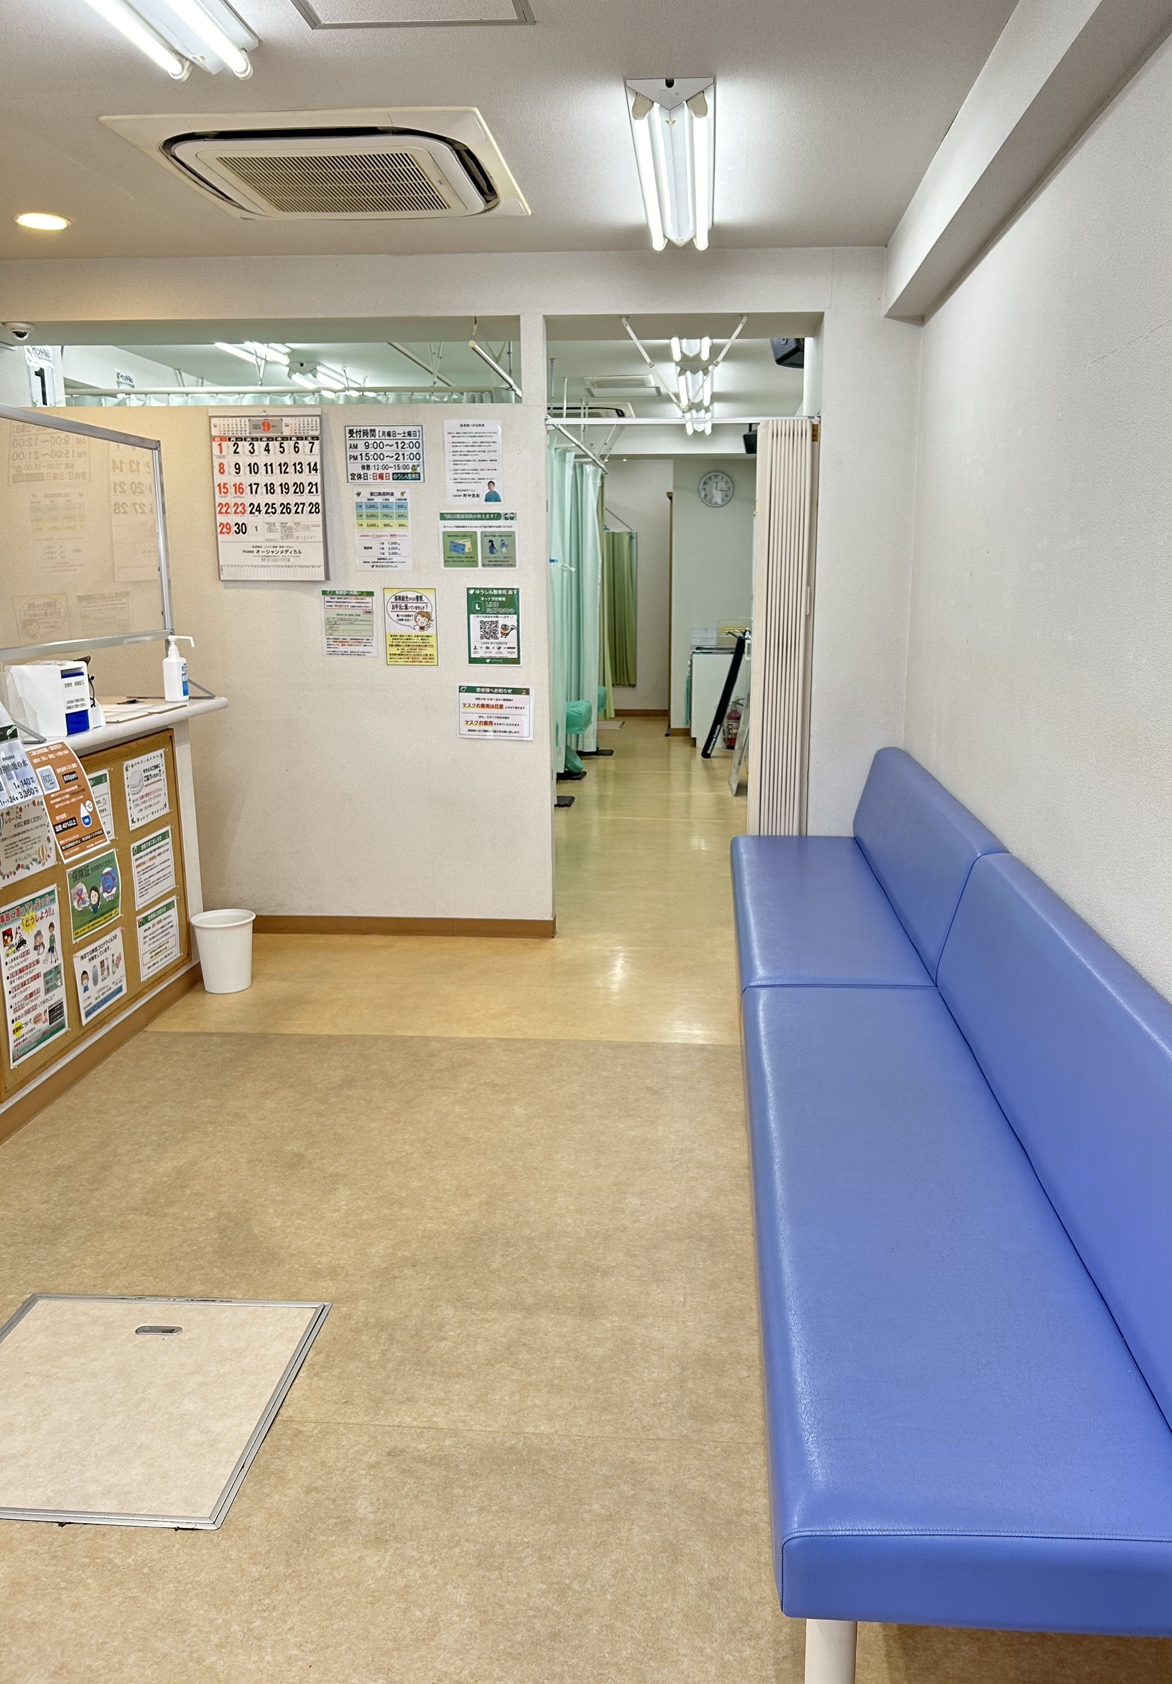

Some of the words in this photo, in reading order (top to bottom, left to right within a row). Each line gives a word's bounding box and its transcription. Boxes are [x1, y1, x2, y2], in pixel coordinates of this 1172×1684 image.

[34, 367, 48, 406] 1
[262, 421, 270, 432] 9
[348, 429, 376, 438] 受付時間
[218, 442, 223, 454] 1
[233, 442, 239, 454] 2
[249, 442, 255, 454] 3
[264, 442, 270, 454] 4
[280, 442, 285, 454] 5
[294, 442, 300, 454] 6
[309, 442, 315, 453] 7
[219, 463, 225, 474] 8
[234, 462, 240, 474] 9
[248, 462, 259, 474] 10
[264, 462, 274, 474] 11
[278, 462, 289, 474] 12
[293, 462, 303, 474] 13
[307, 462, 318, 474] 14
[217, 483, 229, 494] 15
[233, 483, 244, 494] 16
[248, 483, 259, 494] 17
[264, 483, 275, 494] 18
[279, 482, 289, 494] 19
[293, 482, 304, 494] 20
[308, 482, 318, 494] 21
[218, 503, 230, 514] 22
[233, 503, 246, 514] 23
[249, 503, 262, 514] 24
[264, 503, 276, 514] 25
[280, 503, 291, 514] 26
[294, 502, 305, 514] 27
[308, 502, 320, 514] 28
[219, 523, 231, 534] 29
[234, 523, 247, 534] 30
